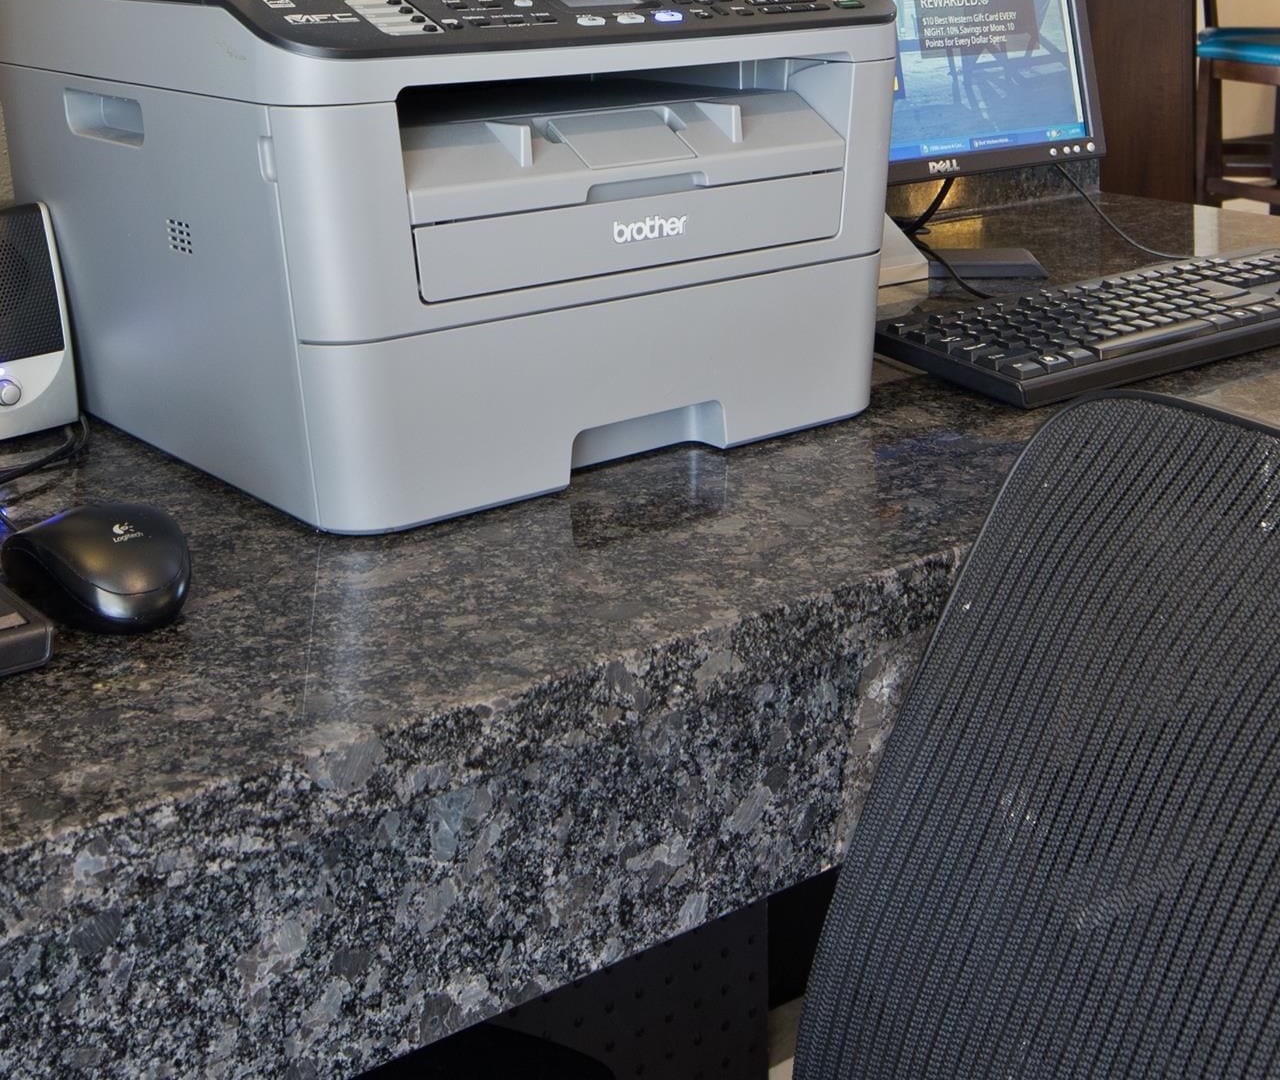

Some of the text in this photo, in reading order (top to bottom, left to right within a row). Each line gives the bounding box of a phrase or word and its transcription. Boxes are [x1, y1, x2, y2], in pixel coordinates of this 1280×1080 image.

[283, 13, 360, 25] MFC
[923, 16, 934, 26] $10
[935, 16, 948, 25] Best
[949, 14, 973, 24] Western
[985, 12, 998, 21] Card
[1000, 11, 1016, 20] EVERY
[924, 27, 946, 37] NIGHT.
[960, 25, 981, 36] Savings
[990, 23, 1007, 32] More.
[925, 35, 1007, 48] Points for Every Dollar Spent.
[928, 159, 960, 174] DELL
[613, 216, 687, 243] brother
[113, 531, 144, 543] Logitech
